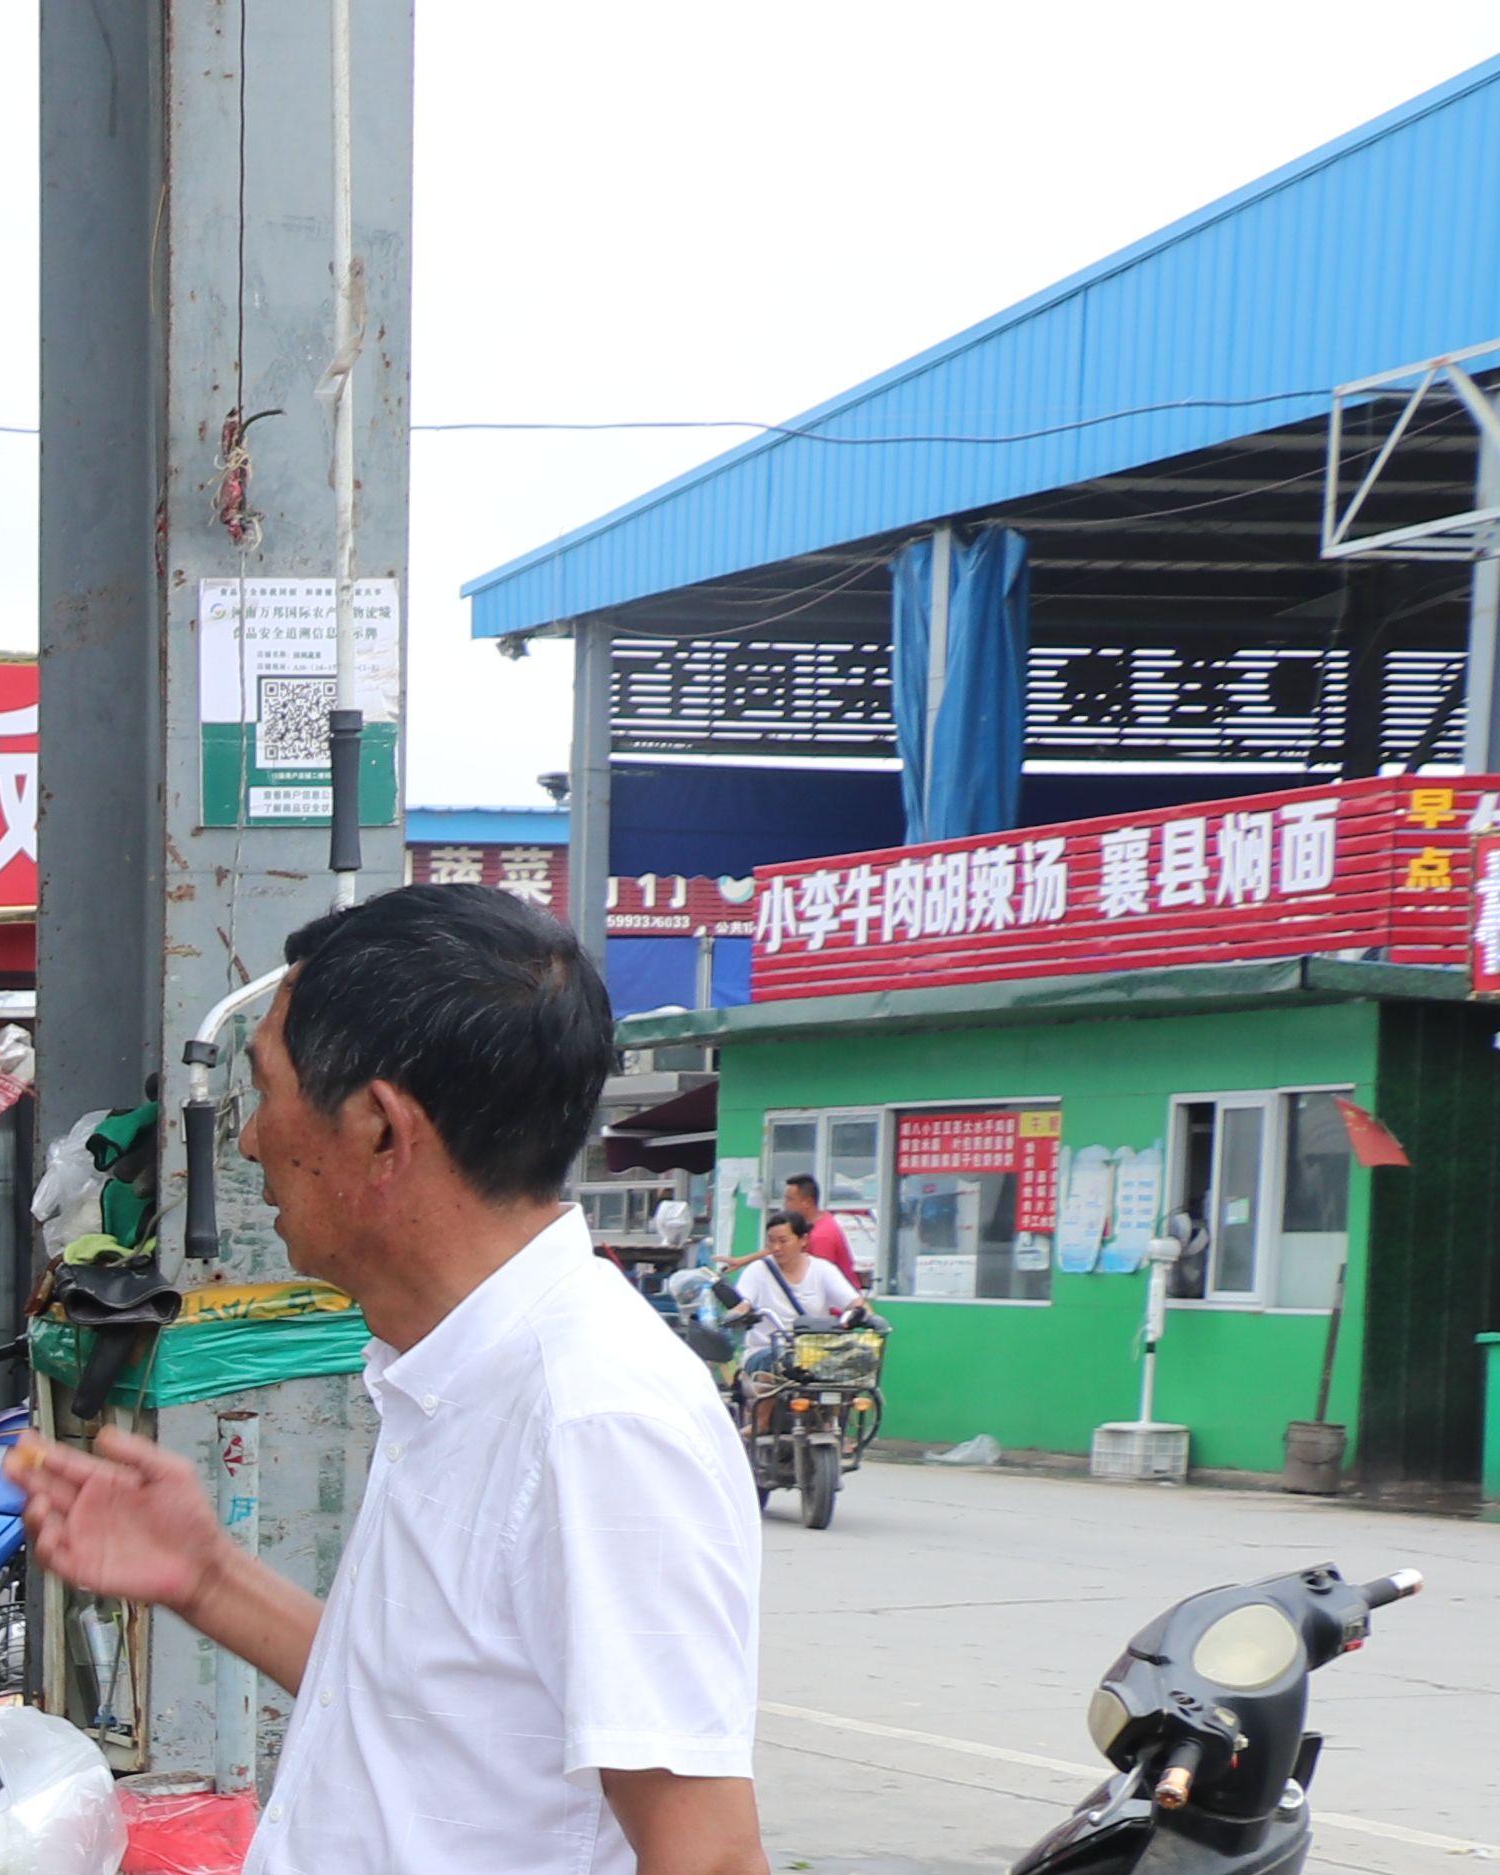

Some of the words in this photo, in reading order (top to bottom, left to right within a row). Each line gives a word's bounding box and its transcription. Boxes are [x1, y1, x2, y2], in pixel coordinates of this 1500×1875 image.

[231, 605, 391, 619] 河南万邦国际农产物流城
[233, 626, 377, 640] 食品安全追溯信息示牌
[1406, 788, 1456, 888] 早点
[404, 845, 554, 906] 蔬菜
[755, 836, 1069, 954] 小李牛肉胡辣汤
